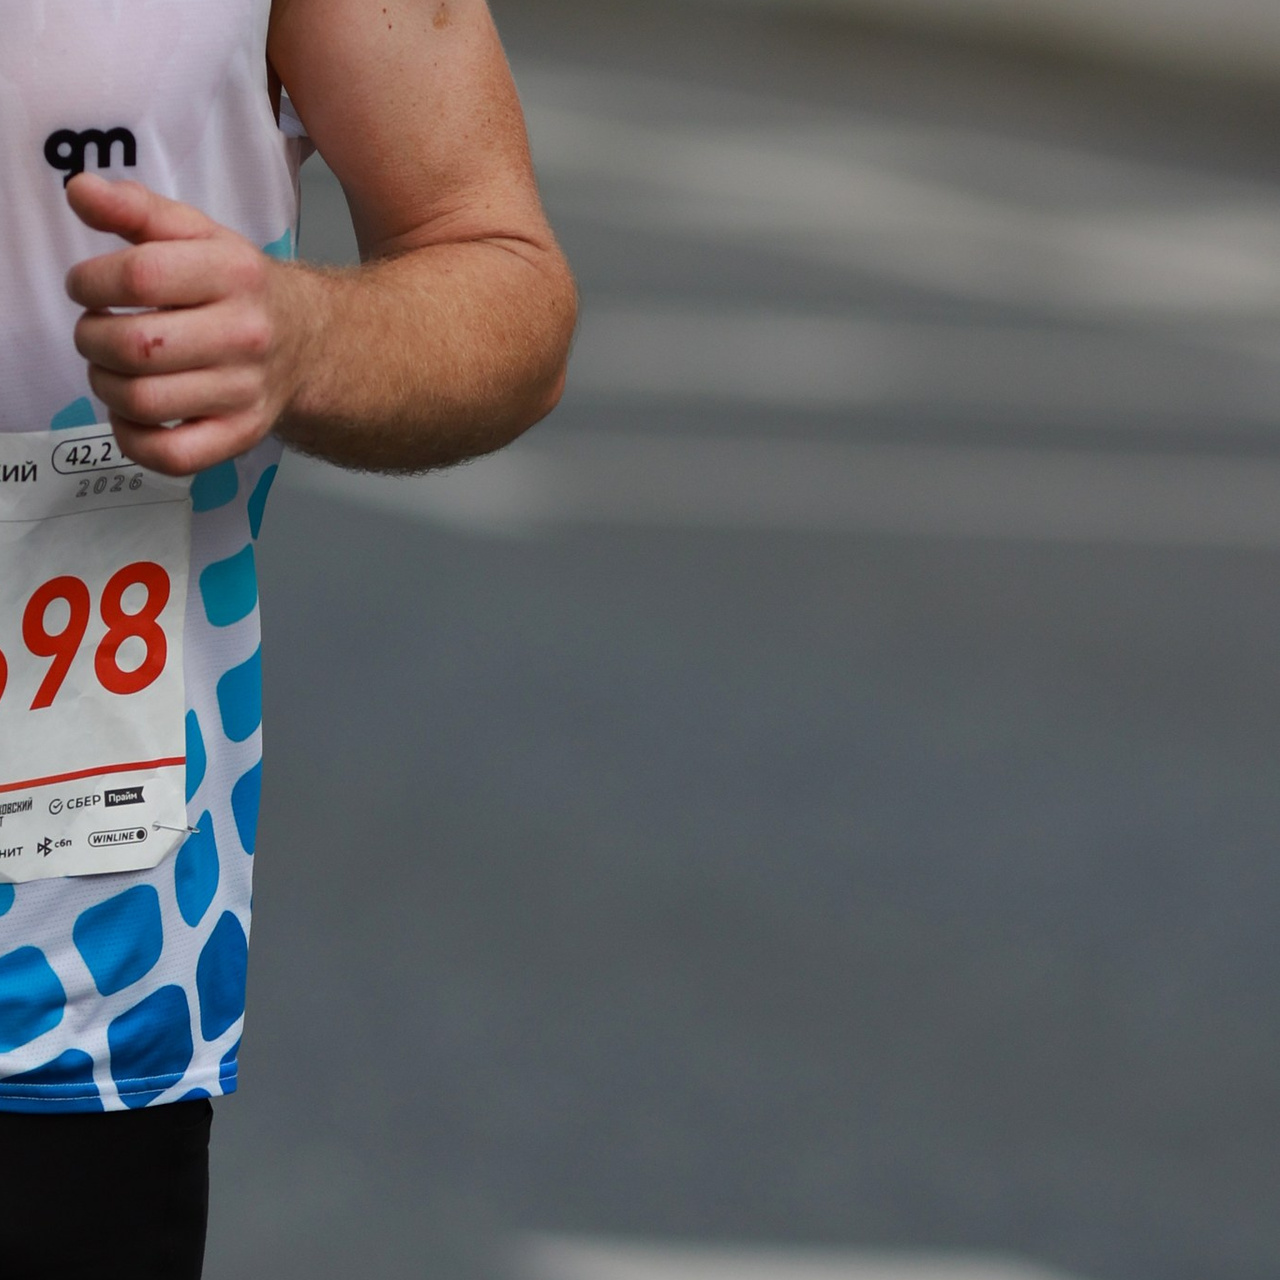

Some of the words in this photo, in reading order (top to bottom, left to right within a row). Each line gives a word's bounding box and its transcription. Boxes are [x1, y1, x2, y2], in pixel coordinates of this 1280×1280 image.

[65, 442, 112, 466] 42,2
[76, 472, 144, 498] 2026
[66, 794, 101, 810] СБЕР
[108, 791, 138, 804] Прайм
[92, 831, 135, 844] WINLINE
